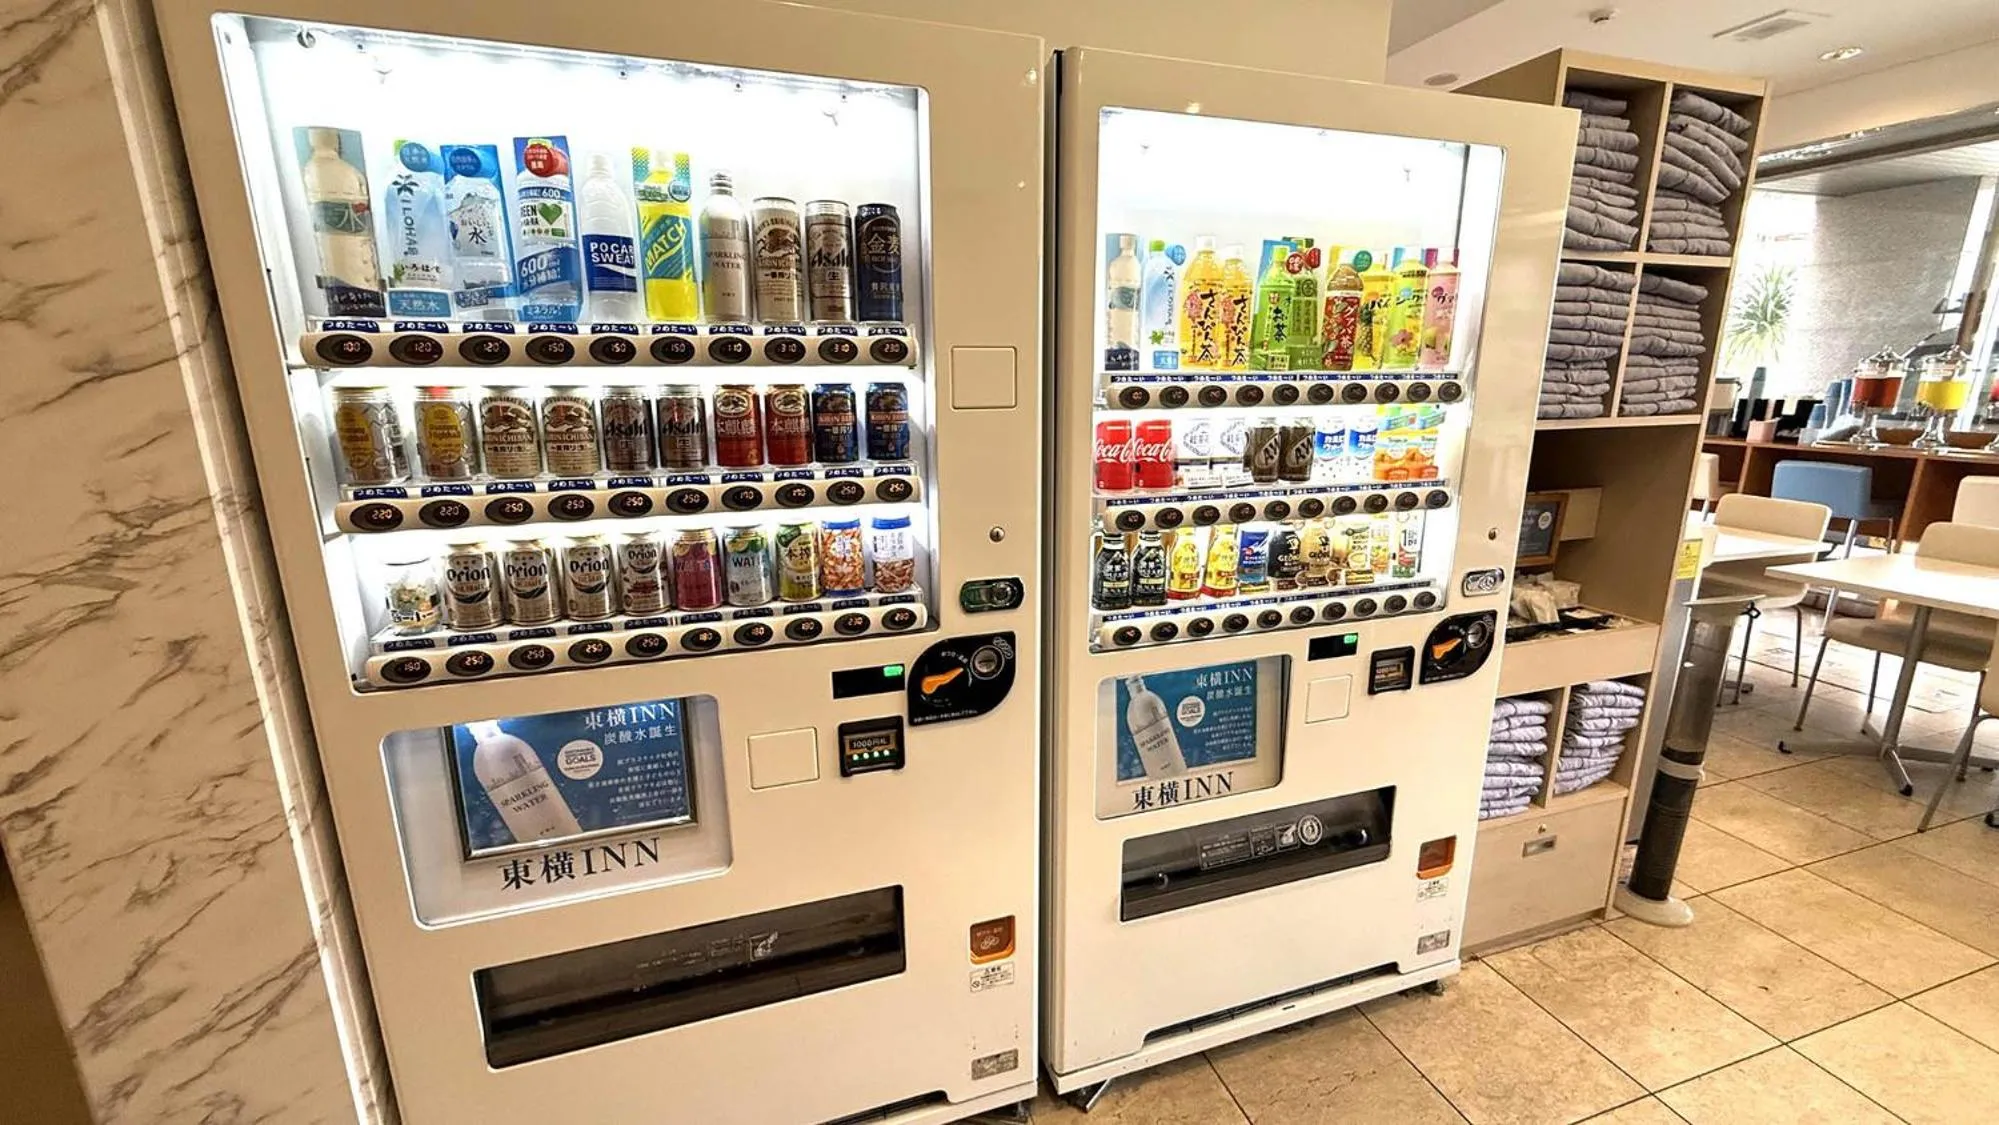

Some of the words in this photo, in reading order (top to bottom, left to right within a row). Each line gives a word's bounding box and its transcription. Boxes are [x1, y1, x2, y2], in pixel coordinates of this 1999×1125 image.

[468, 227, 488, 245] 水
[520, 254, 549, 278] 600
[414, 342, 432, 352] 120
[548, 343, 564, 353] 150
[611, 343, 626, 353] 150
[671, 343, 686, 353] 150
[604, 419, 649, 437] Asahi
[661, 416, 704, 435] Asahi
[628, 548, 657, 561] Orion
[507, 562, 549, 579] Orion
[570, 555, 609, 573] Orion
[446, 566, 491, 582] Orion
[1195, 667, 1253, 689] 東横INN
[584, 702, 676, 731] 東横INN
[604, 723, 677, 746] 炭酸水誕生
[1131, 771, 1235, 811] 東横INN
[512, 793, 548, 814] WATER
[497, 836, 661, 892] 東横INN
